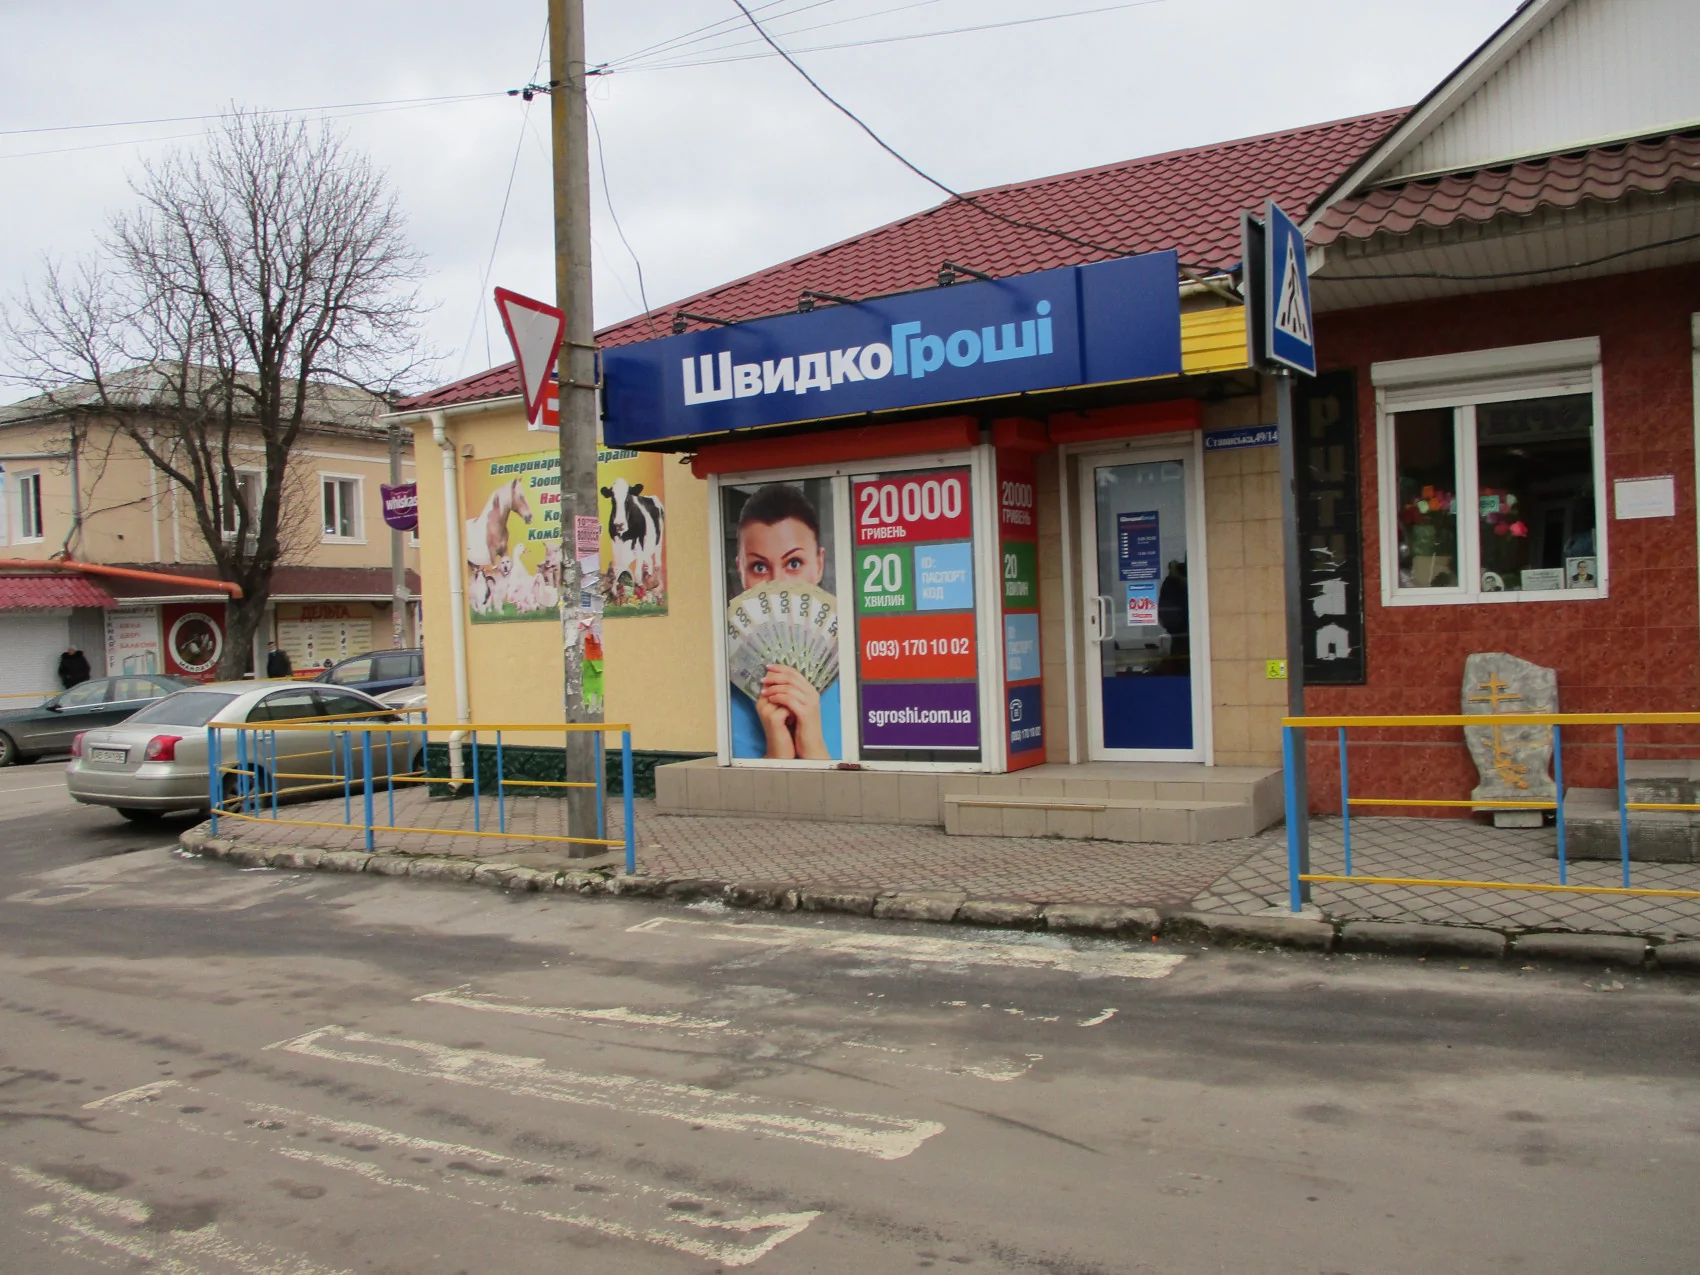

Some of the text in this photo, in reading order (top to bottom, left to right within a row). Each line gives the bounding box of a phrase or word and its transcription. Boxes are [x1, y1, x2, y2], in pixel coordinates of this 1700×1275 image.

[682, 300, 1053, 406] ШвидкоГроші
[490, 458, 562, 475] Ветеринарн
[862, 526, 906, 540] ГРИВЕНЬ
[863, 553, 902, 592] 20
[922, 570, 966, 583] ПАСПОРТ
[1004, 554, 1017, 579] 20
[758, 591, 771, 615] 500
[779, 590, 791, 614] 500
[864, 594, 905, 608] ХВИЛИН
[923, 587, 944, 599] КОД
[301, 604, 350, 622] ДЕЛЬТА
[799, 593, 810, 617] 500
[814, 603, 831, 628] 500
[735, 606, 751, 628] 500
[866, 638, 969, 660] (093) 170 10 02
[868, 706, 971, 730] sgroshi.com.ua
